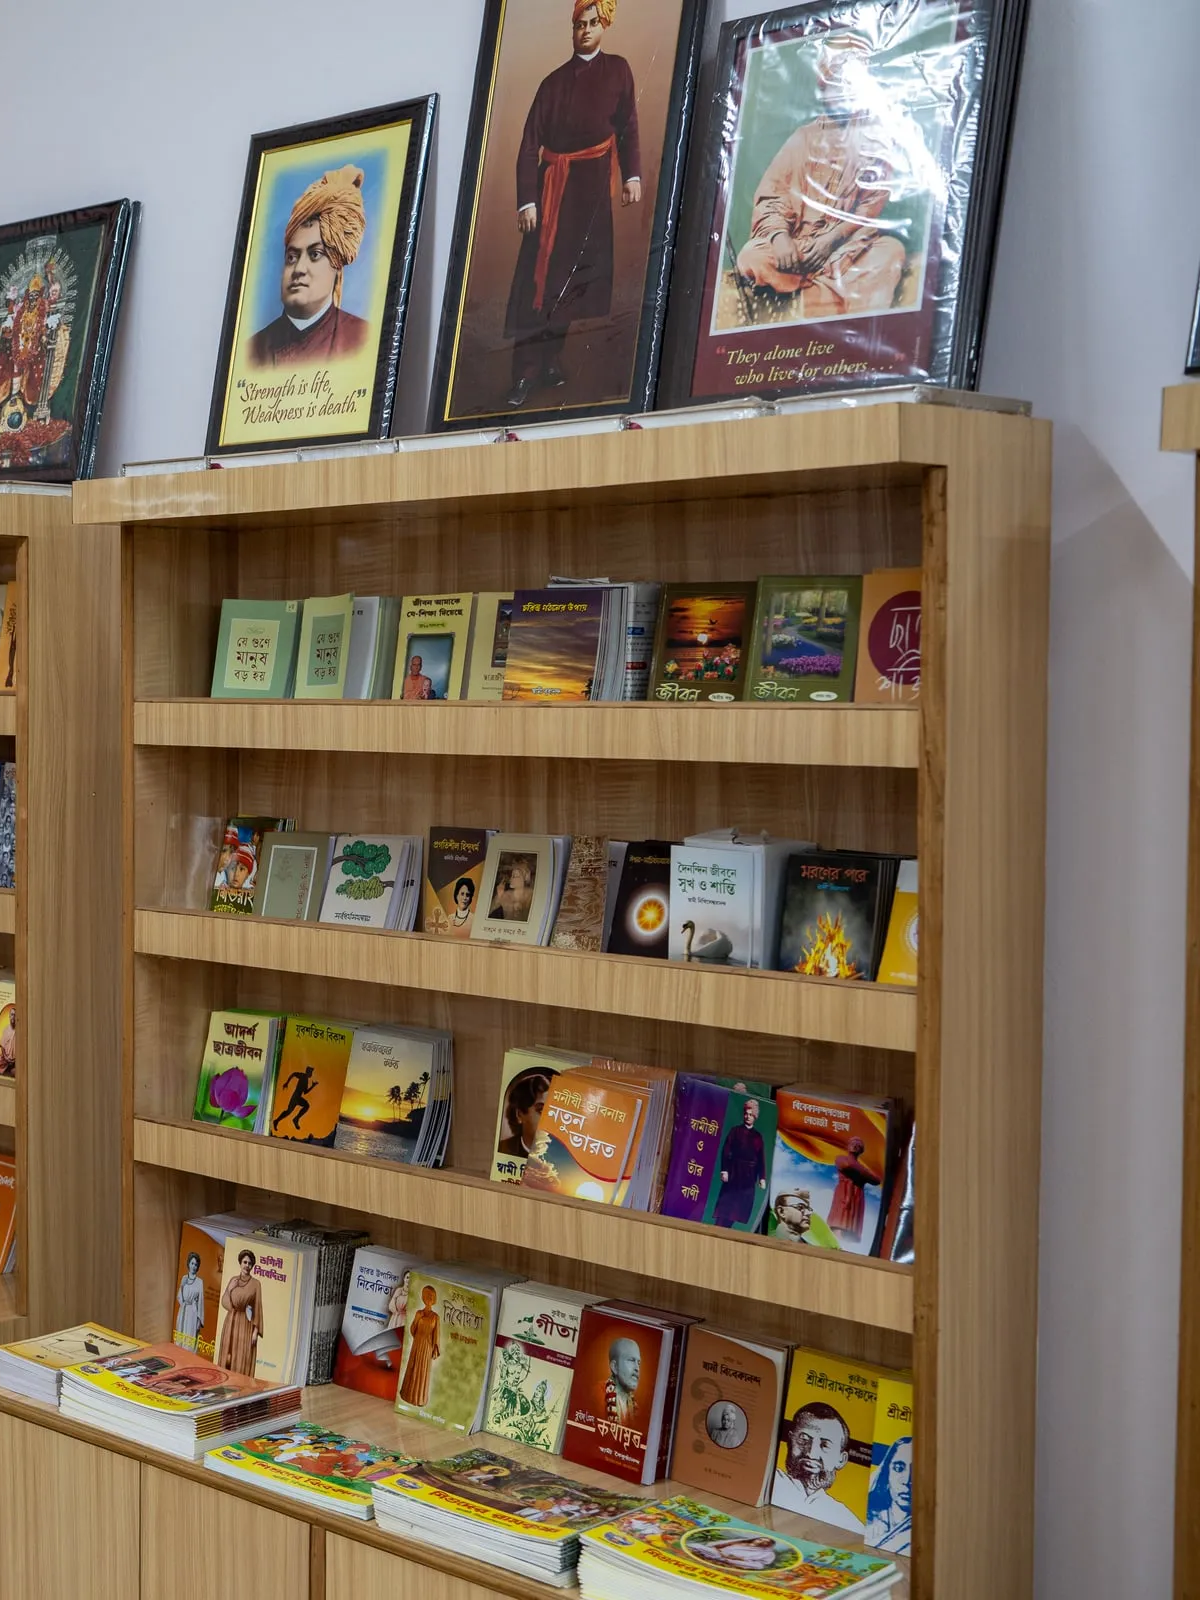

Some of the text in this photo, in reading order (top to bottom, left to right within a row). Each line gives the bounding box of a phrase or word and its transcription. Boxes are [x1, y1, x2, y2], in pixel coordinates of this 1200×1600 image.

[764, 344, 802, 361] alone
[806, 341, 835, 356] live
[734, 368, 764, 386] who
[768, 366, 796, 382] live
[796, 363, 820, 384] for
[298, 379, 308, 396] is
[310, 371, 332, 399] life,
[242, 399, 304, 424] Weakness
[306, 402, 317, 418] is
[237, 636, 271, 649] যে গুণে
[236, 650, 268, 669] মানুষ
[315, 646, 339, 665] মানুষ
[234, 669, 266, 683] বড় হয়
[314, 667, 326, 680] বড়
[753, 682, 801, 700] জীবন
[677, 861, 737, 878] দৈনন্দিন জীবনে
[800, 864, 843, 881] মরণের
[678, 877, 737, 895] সুখ ও শান্তি
[223, 1021, 260, 1042] আদর্শ
[295, 1022, 346, 1045] যুবশক্তির বিকাশ
[213, 1040, 263, 1062] ছাত্রজীবন
[553, 1090, 582, 1109] মনীষী
[547, 1105, 587, 1134] নতুন
[690, 1116, 719, 1137] স্বামীজী
[568, 1130, 616, 1159] ভারত
[696, 1140, 704, 1152] ও
[497, 1161, 518, 1177] স্বামী
[687, 1159, 703, 1177] তাঁর
[681, 1184, 699, 1201] বাণী
[259, 1255, 284, 1269] ভগিনী
[254, 1265, 287, 1283] নিবেদিতা
[356, 1274, 394, 1297] নিবেদিতা
[442, 1300, 485, 1330] নিবেদিতা
[535, 1312, 578, 1343] গীতা
[702, 1360, 763, 1388] স্বামী বিবেকানন্দ
[596, 1417, 643, 1451] কথামৃত
[428, 1490, 490, 1515] শিশুদের
[643, 1548, 699, 1573] শিশুদের
